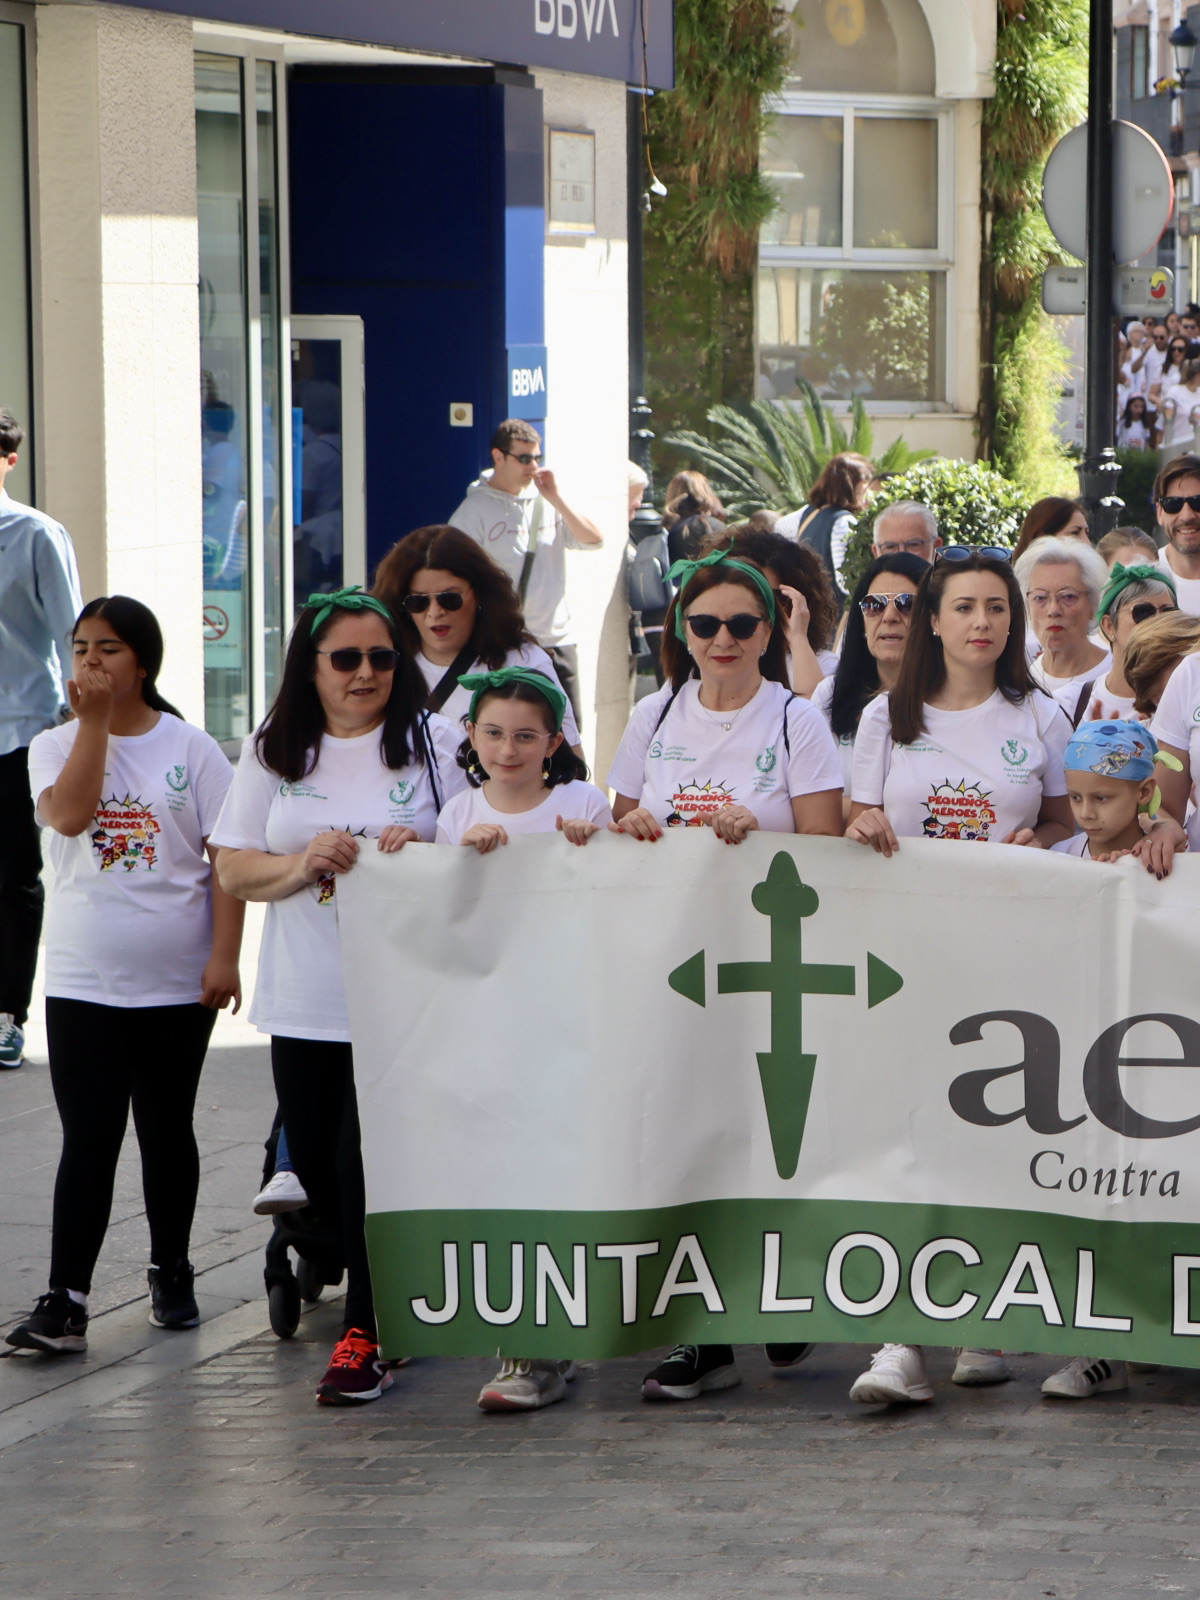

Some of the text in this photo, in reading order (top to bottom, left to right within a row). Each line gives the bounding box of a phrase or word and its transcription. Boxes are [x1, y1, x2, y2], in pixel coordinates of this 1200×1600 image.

[512, 366, 545, 396] BBVA
[673, 791, 733, 803] PEQUEÑOS
[928, 794, 991, 808] PEQUEÑOS
[96, 808, 153, 819] PEQUEÑOS
[1029, 1150, 1180, 1198] Contra
[409, 1236, 727, 1328] JUNTA
[759, 1231, 1133, 1333] LOCAL
